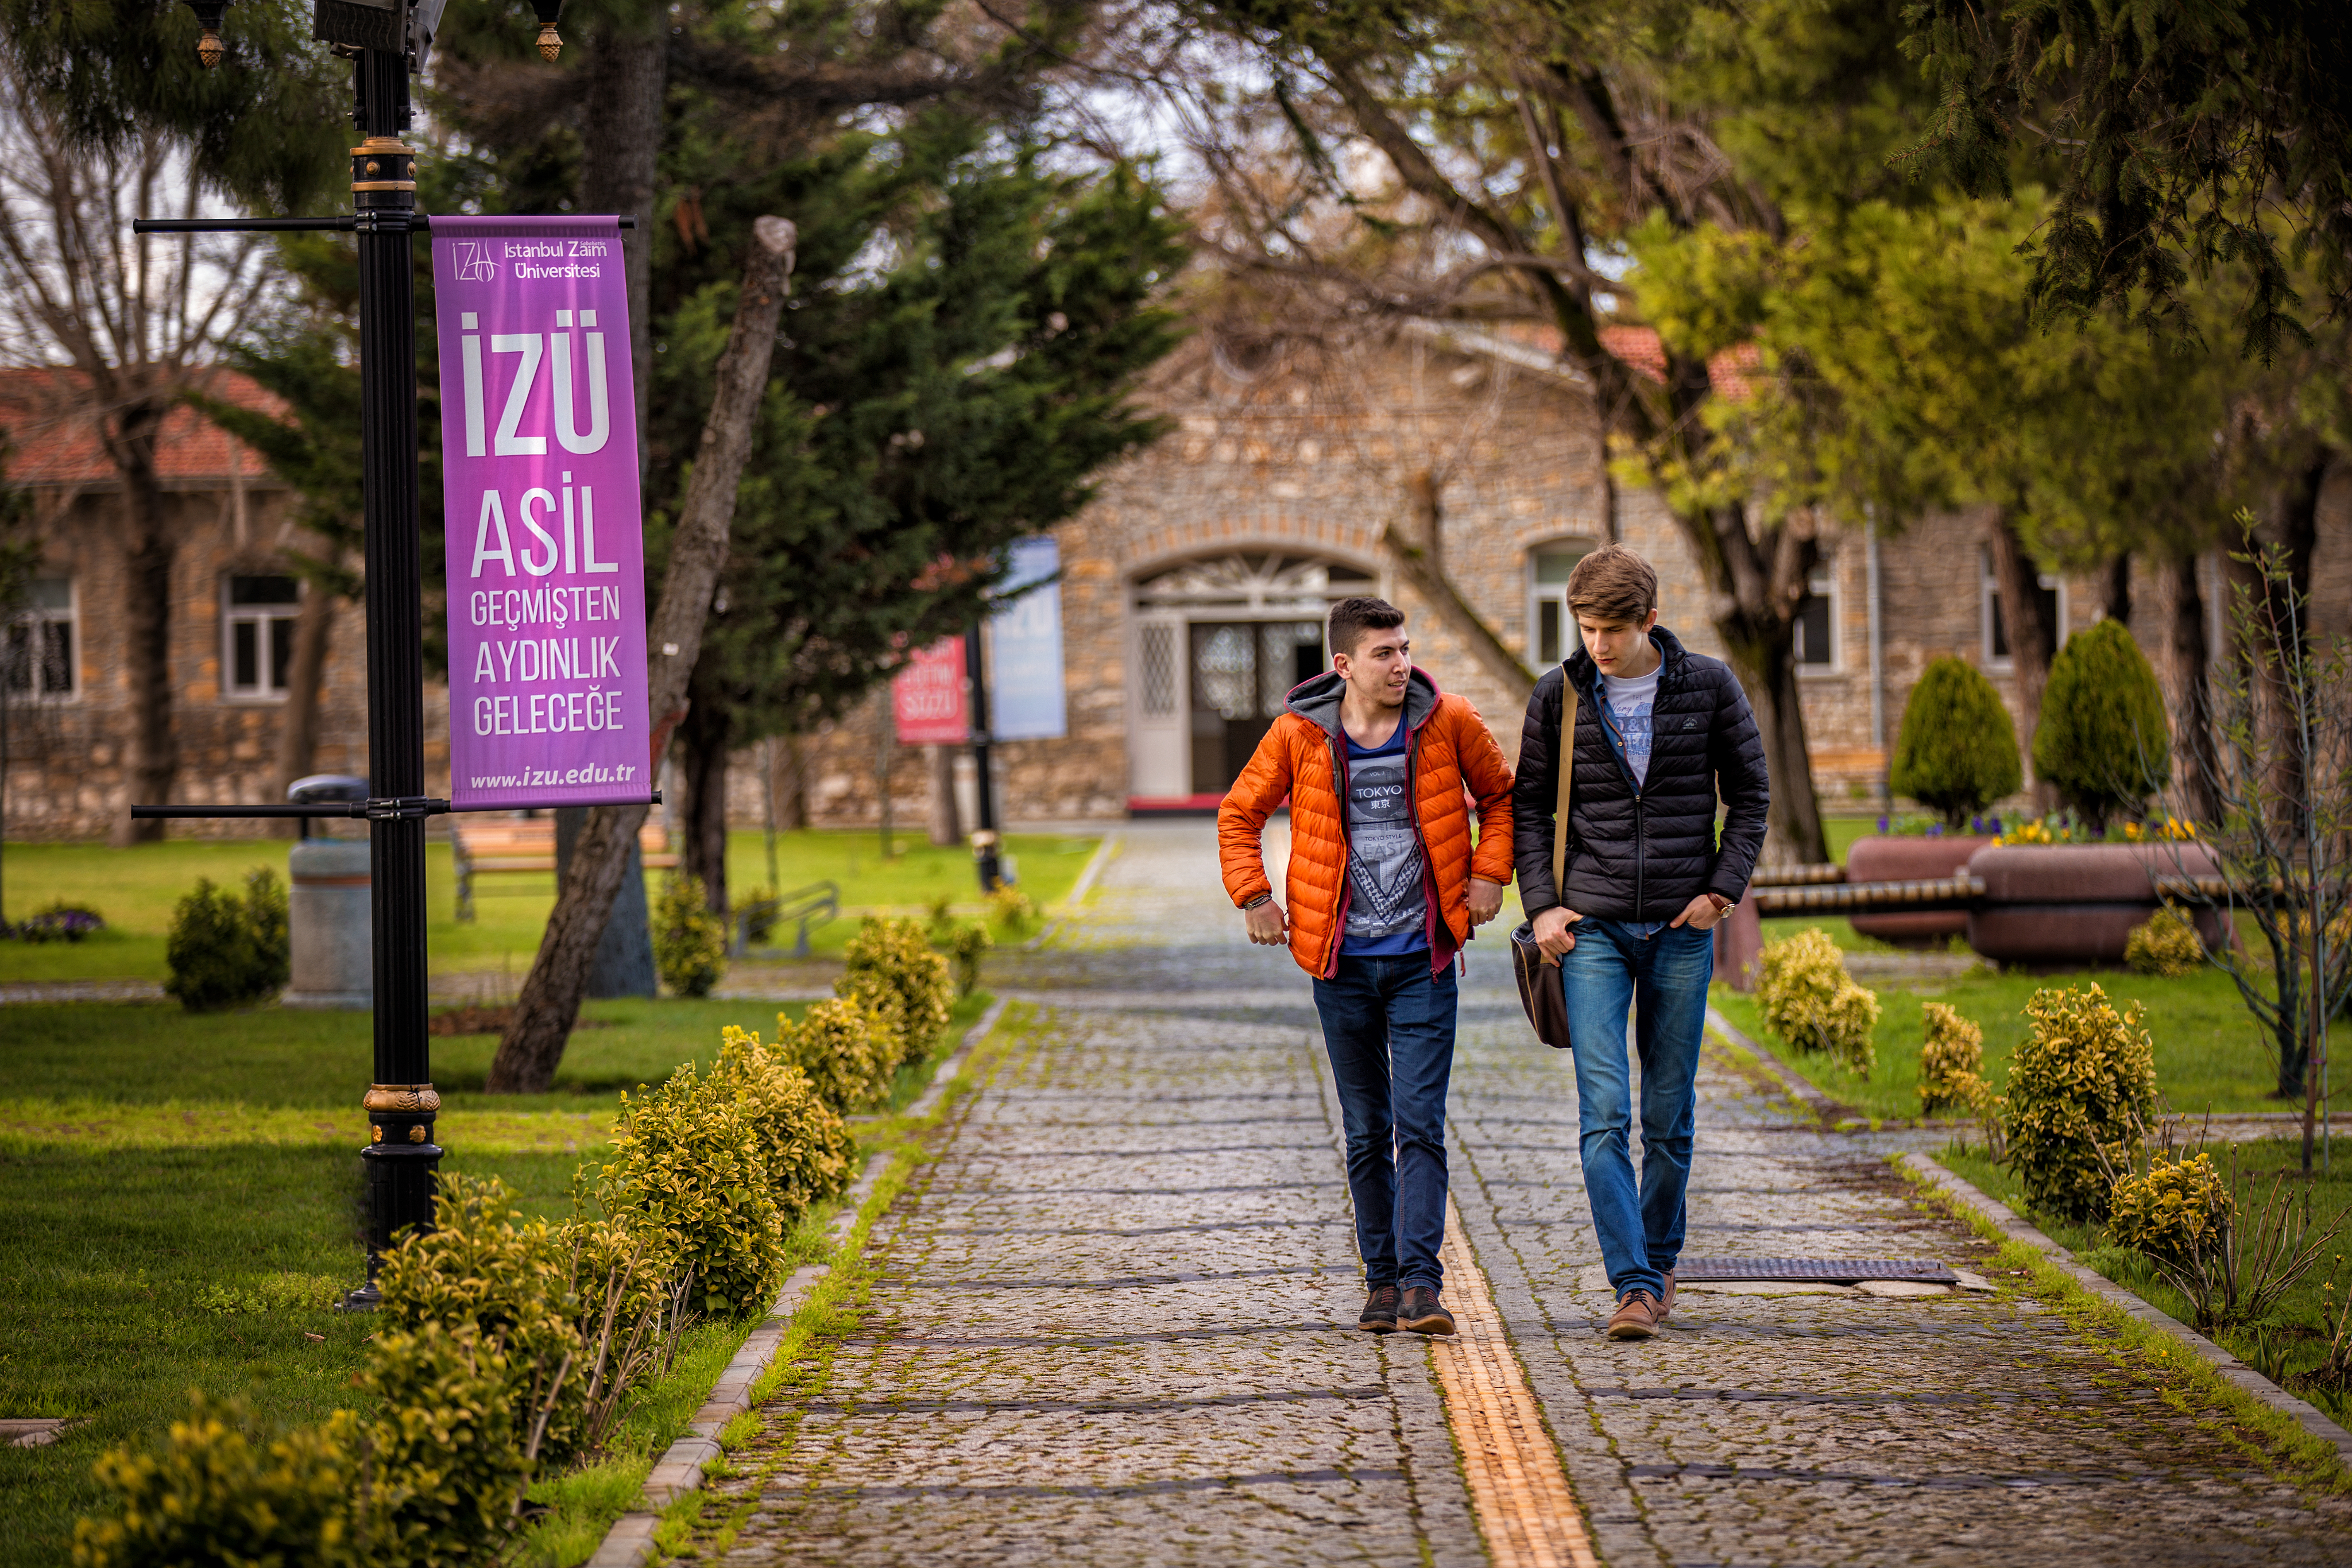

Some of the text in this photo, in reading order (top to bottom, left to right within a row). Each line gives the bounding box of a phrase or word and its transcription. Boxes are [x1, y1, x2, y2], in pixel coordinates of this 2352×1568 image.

[505, 241, 607, 258] İstanbul Zaim
[515, 262, 600, 278] Üniversitesi
[461, 309, 609, 457] İZÜ
[471, 471, 618, 578] ASİL
[471, 582, 620, 632] GEÇMİŞTEN
[474, 636, 621, 683] AYDINLIK
[474, 684, 624, 735] GELECEĞE
[1628, 718, 1639, 732] &
[471, 762, 636, 788] www.izu.edu.tr
[1356, 785, 1402, 799] TOKYO
[1371, 799, 1390, 810] 東京
[1363, 840, 1406, 858] EAST
